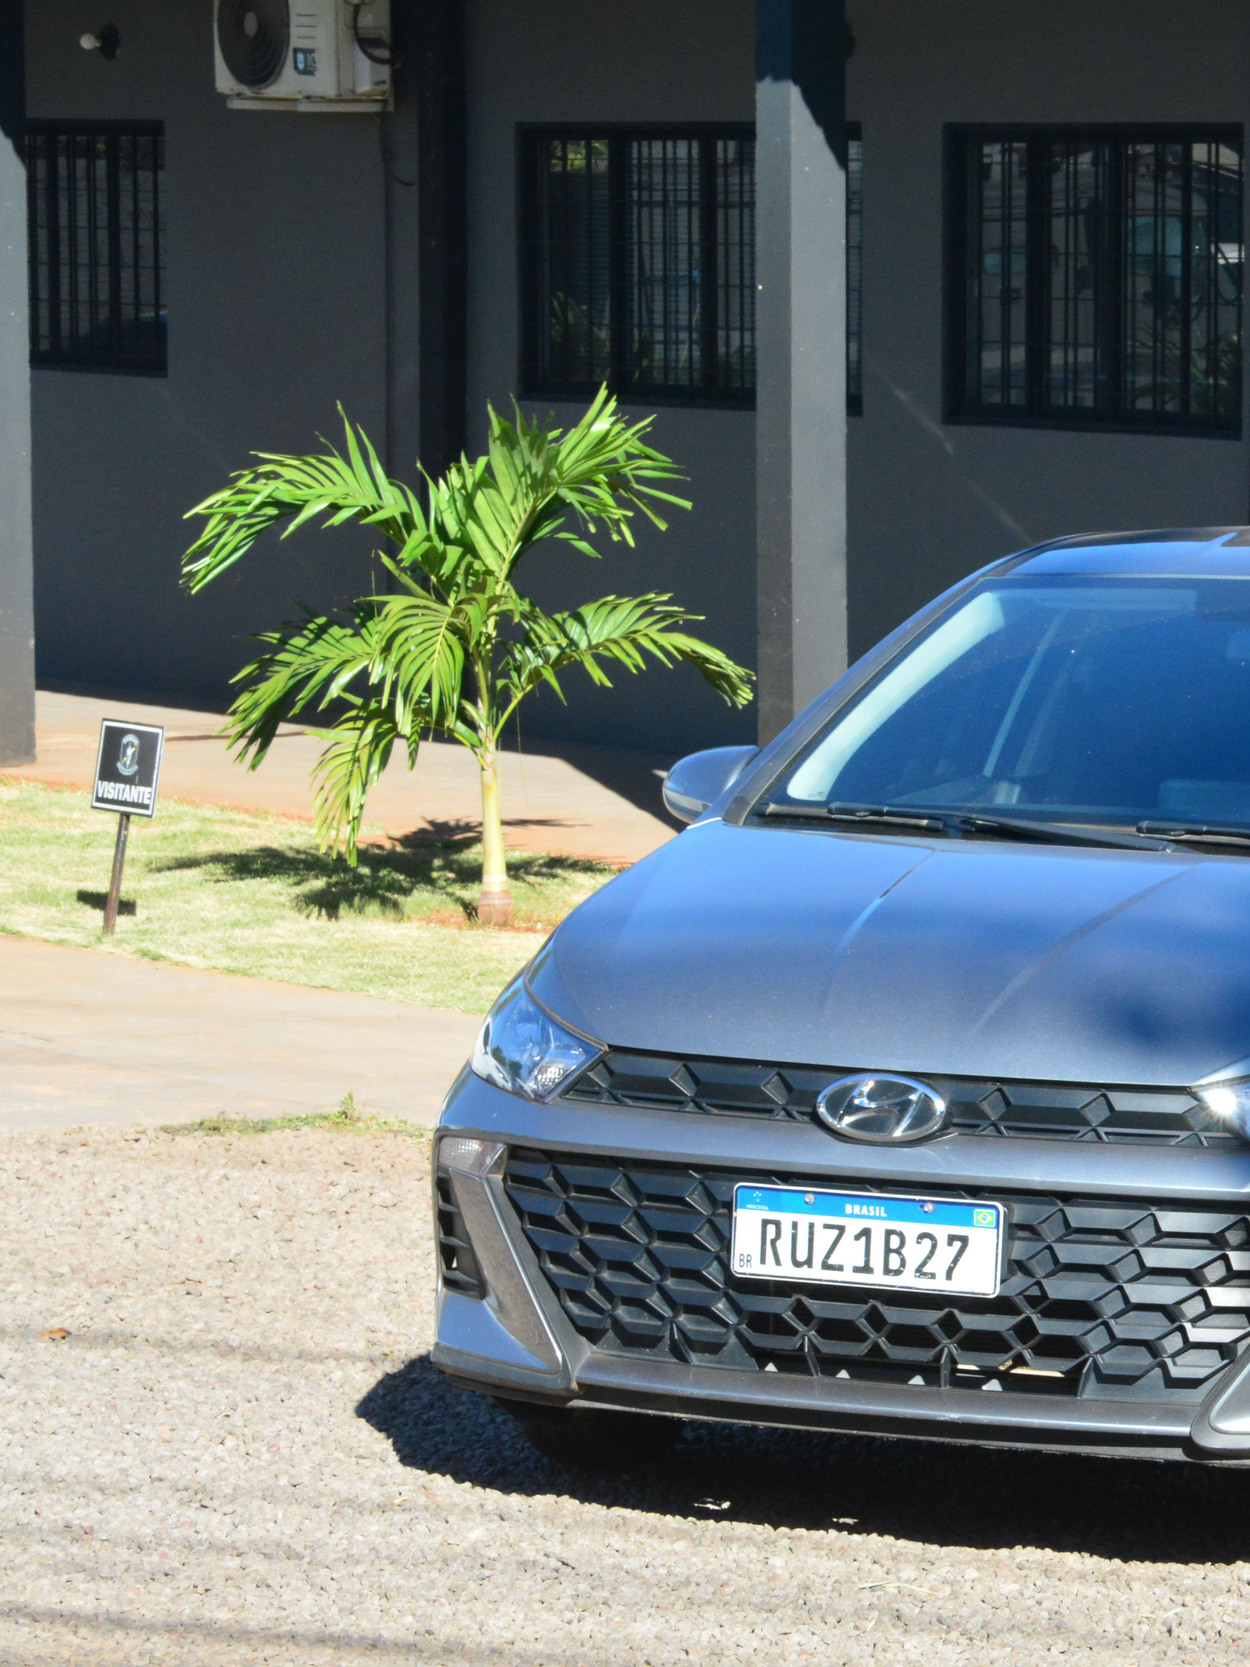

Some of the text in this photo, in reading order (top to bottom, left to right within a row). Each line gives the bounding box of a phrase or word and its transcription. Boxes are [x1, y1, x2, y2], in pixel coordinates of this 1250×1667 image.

[97, 780, 152, 804] VISITANTE
[845, 1203, 887, 1218] BRASIL
[759, 1218, 970, 1281] RUZ1B27
[739, 1253, 752, 1268] BR
